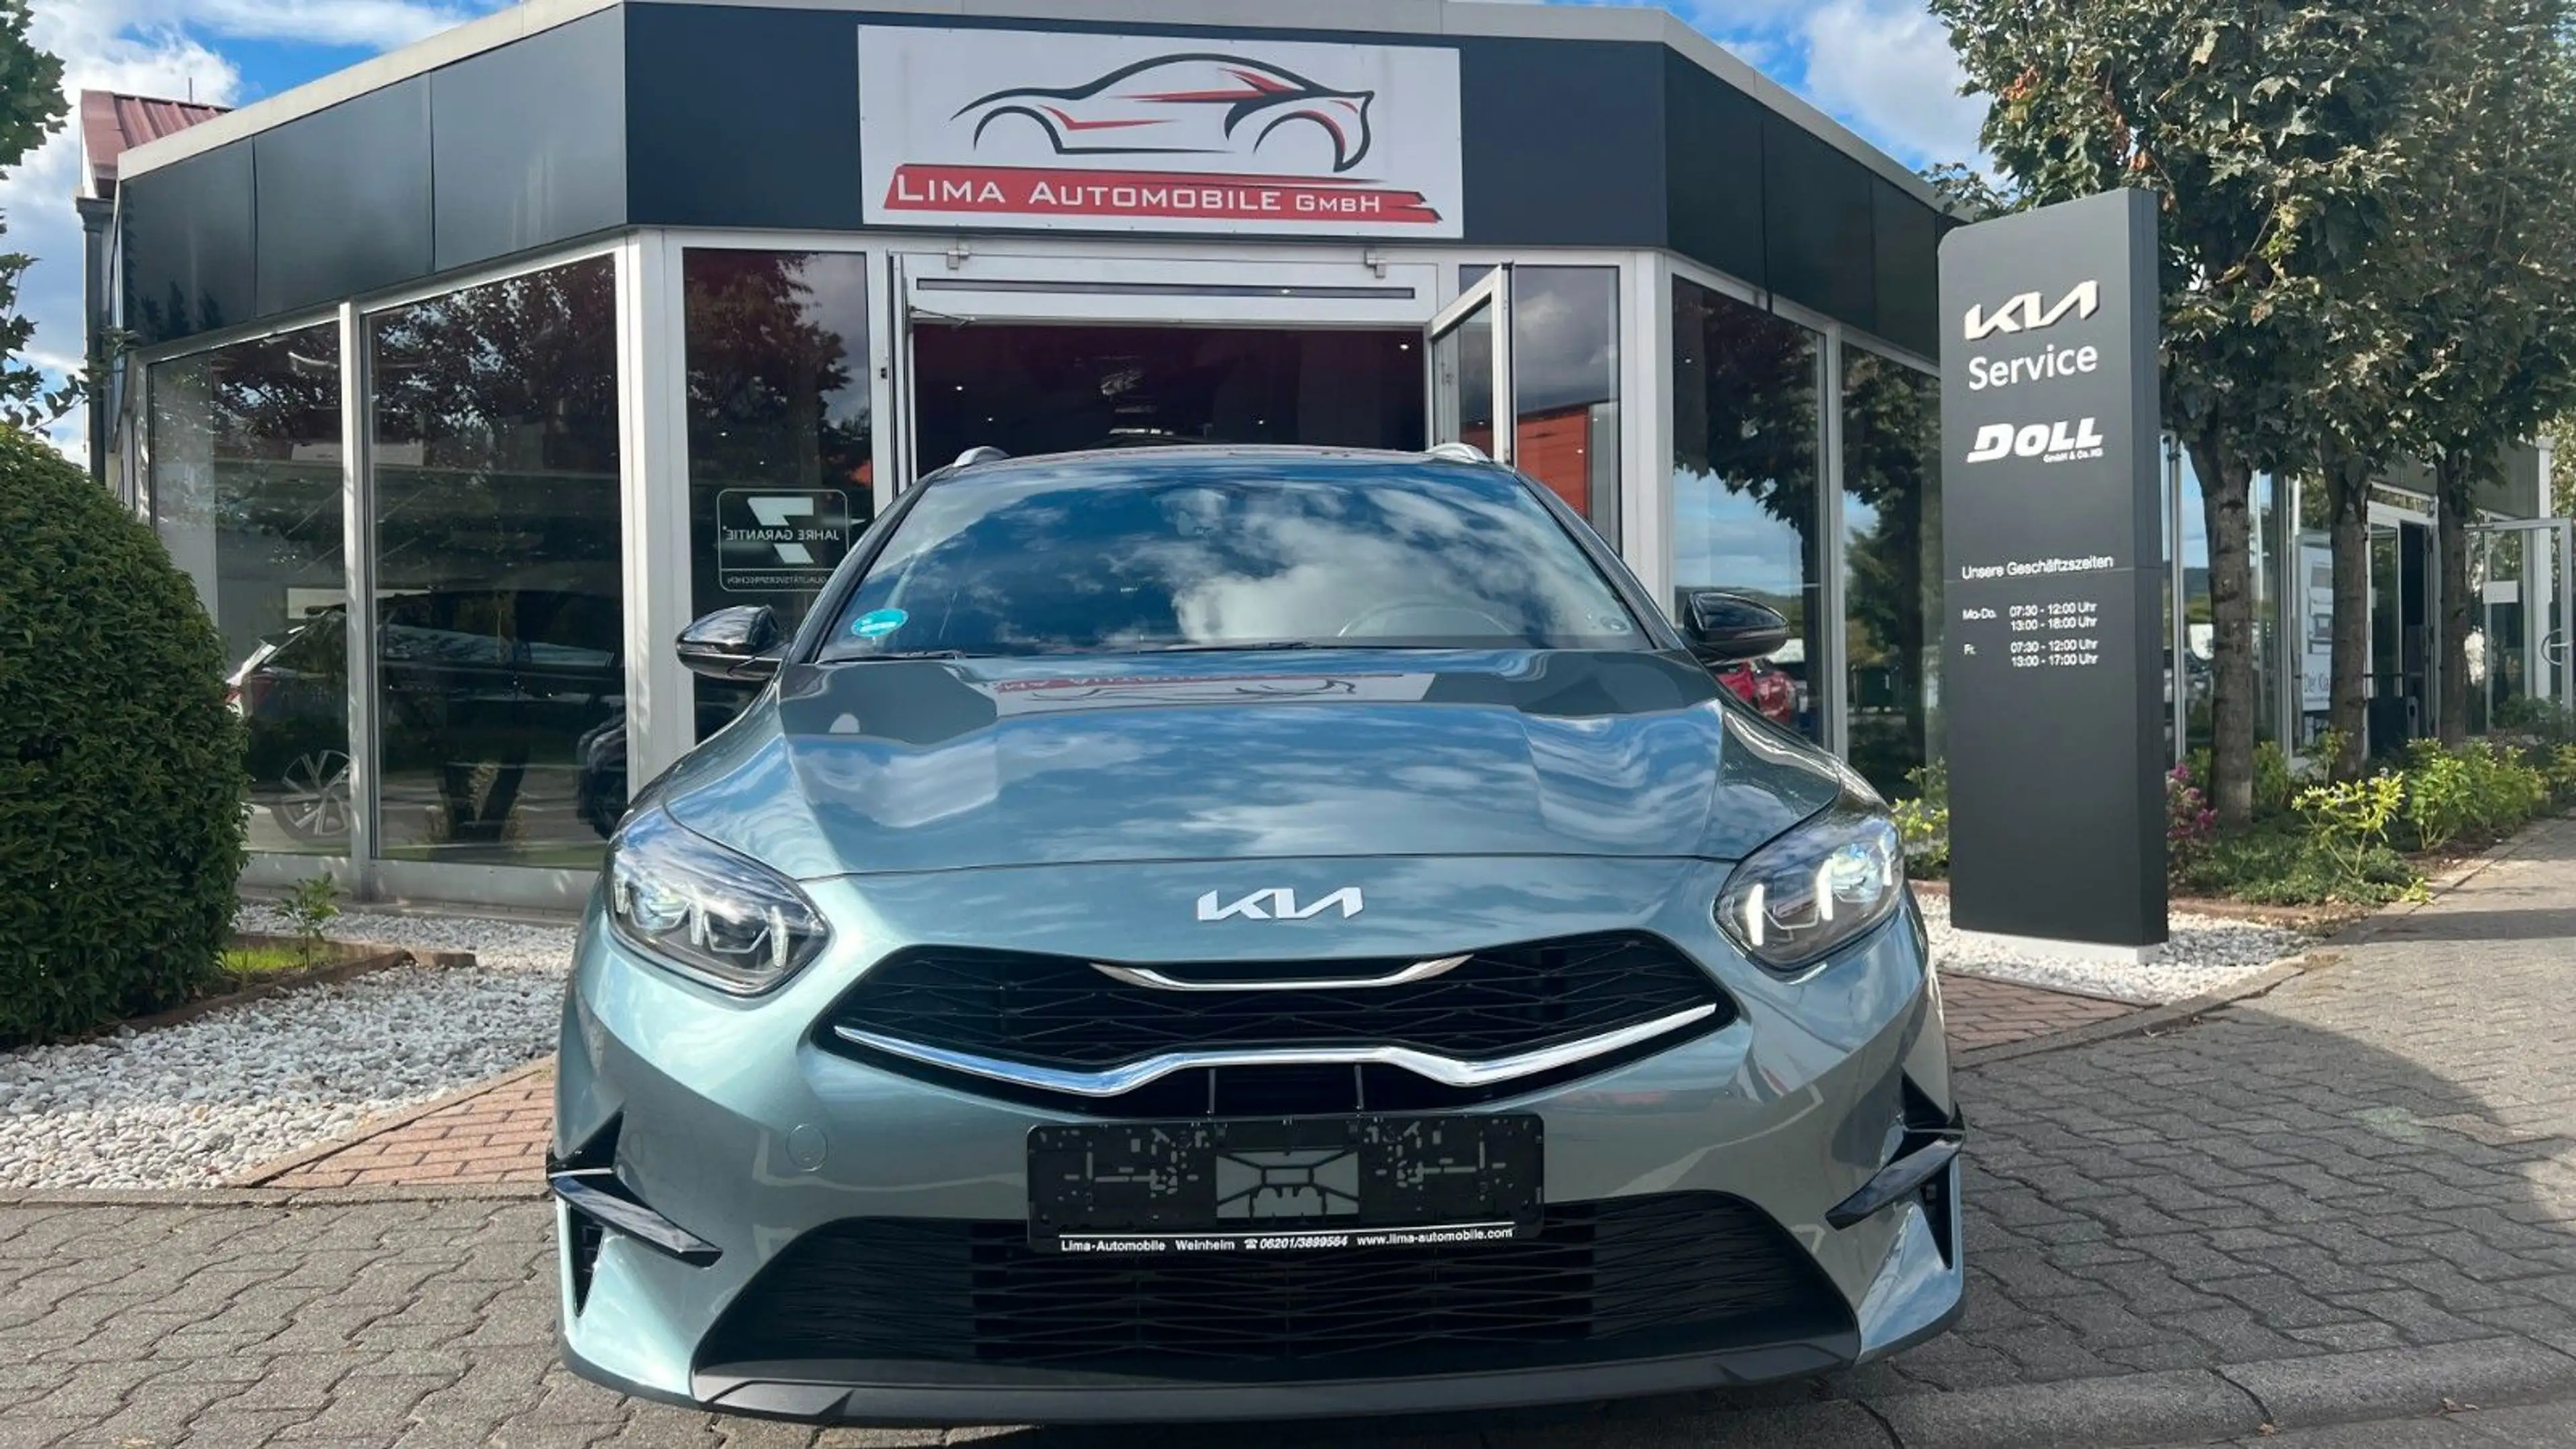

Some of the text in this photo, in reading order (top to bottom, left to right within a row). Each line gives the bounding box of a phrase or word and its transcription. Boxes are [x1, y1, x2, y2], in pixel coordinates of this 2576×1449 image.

[897, 174, 1006, 203] LIMA
[1028, 181, 1281, 211] AUTOMOBILE
[1964, 280, 2099, 340] KIA
[1968, 344, 2098, 390] Service
[1967, 417, 2103, 463] DOLL
[1962, 565, 2004, 580] Unsere
[2009, 605, 2038, 617] 07:30
[2047, 603, 2076, 614] 12:00
[2078, 602, 2098, 613] Uhr
[2011, 619, 2038, 631] 13:00
[2048, 617, 2076, 629] 18:00
[2078, 616, 2098, 628] Uhr
[2010, 641, 2039, 653] 07:30
[2049, 639, 2078, 651] 12:00
[2079, 638, 2098, 649] Uhr
[2012, 655, 2039, 667] 13:00
[2049, 653, 2078, 665] 17:00
[2079, 653, 2098, 665] Uhr
[1197, 887, 1363, 920] KIA
[1061, 1240, 1166, 1252] Lima-Automobile
[1175, 1239, 1236, 1251] Weinheim
[1356, 1228, 1513, 1246] www.lima-automobile.com
